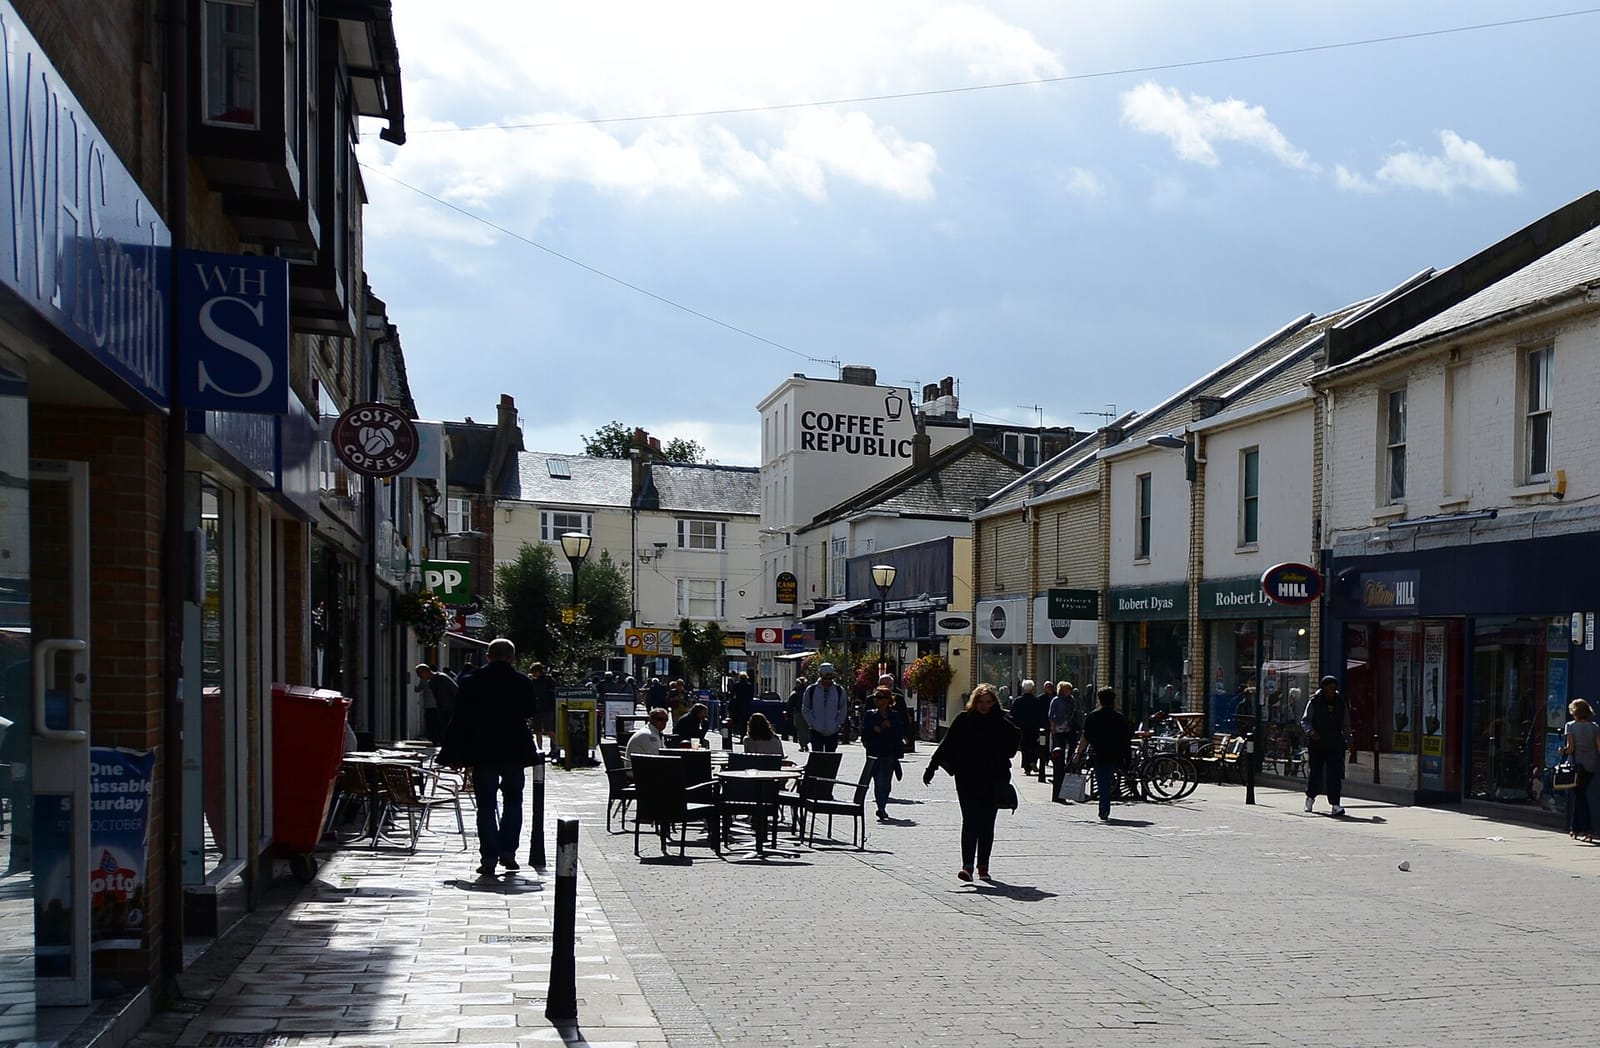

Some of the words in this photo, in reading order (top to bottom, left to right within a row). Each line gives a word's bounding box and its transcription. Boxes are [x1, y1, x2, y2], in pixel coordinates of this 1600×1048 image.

[193, 263, 272, 297] WH
[198, 295, 274, 398] S
[349, 410, 402, 431] COSTA
[801, 410, 885, 437] COFFEE
[344, 444, 407, 470] COFFEE
[801, 431, 913, 458] REPUBLIC
[424, 569, 463, 594] PP
[1277, 583, 1309, 598] HILL
[1396, 580, 1416, 605] HILL
[1118, 597, 1148, 611] Robert
[1150, 596, 1174, 612] Dyas
[1215, 591, 1256, 606] Robert
[1258, 589, 1274, 607] Dy
[91, 818, 143, 832] OCTOBER
[91, 873, 136, 897] otto
